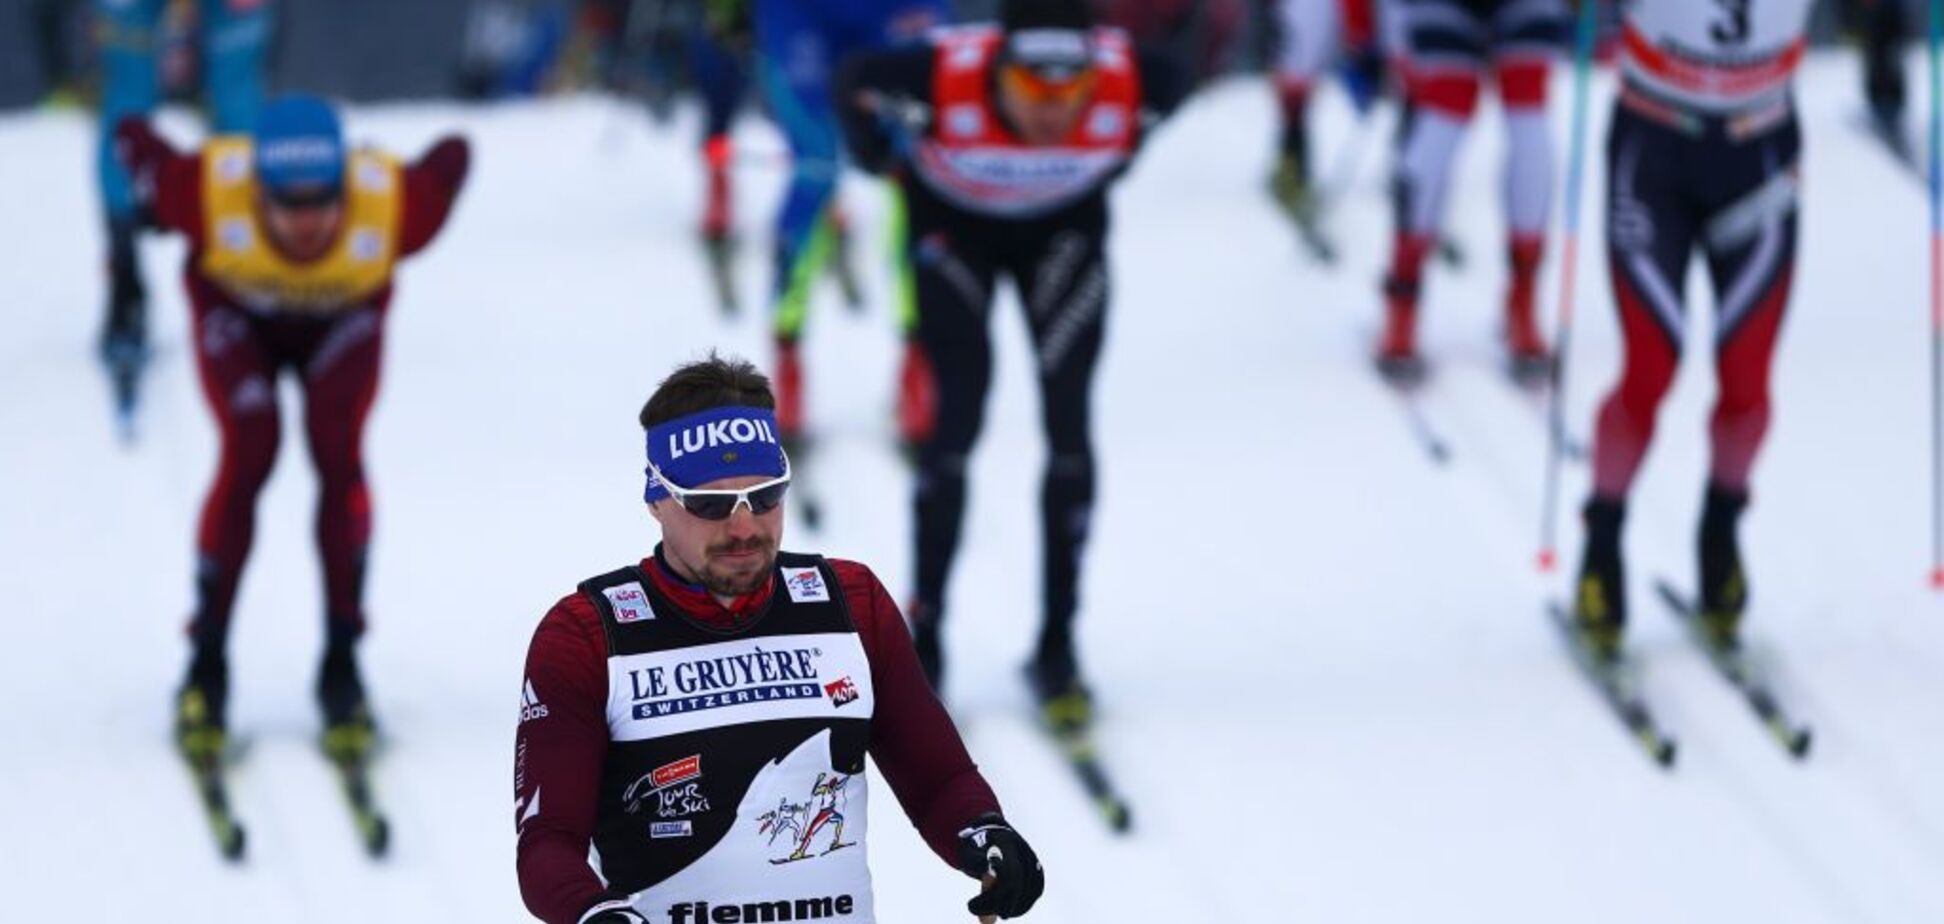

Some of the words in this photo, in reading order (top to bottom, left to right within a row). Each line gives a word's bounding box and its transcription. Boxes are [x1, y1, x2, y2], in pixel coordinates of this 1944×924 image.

[669, 418, 776, 459] LUKOIL
[628, 666, 668, 701] LE
[640, 685, 814, 717] SWITZERLAND
[667, 894, 854, 924] fiemme
